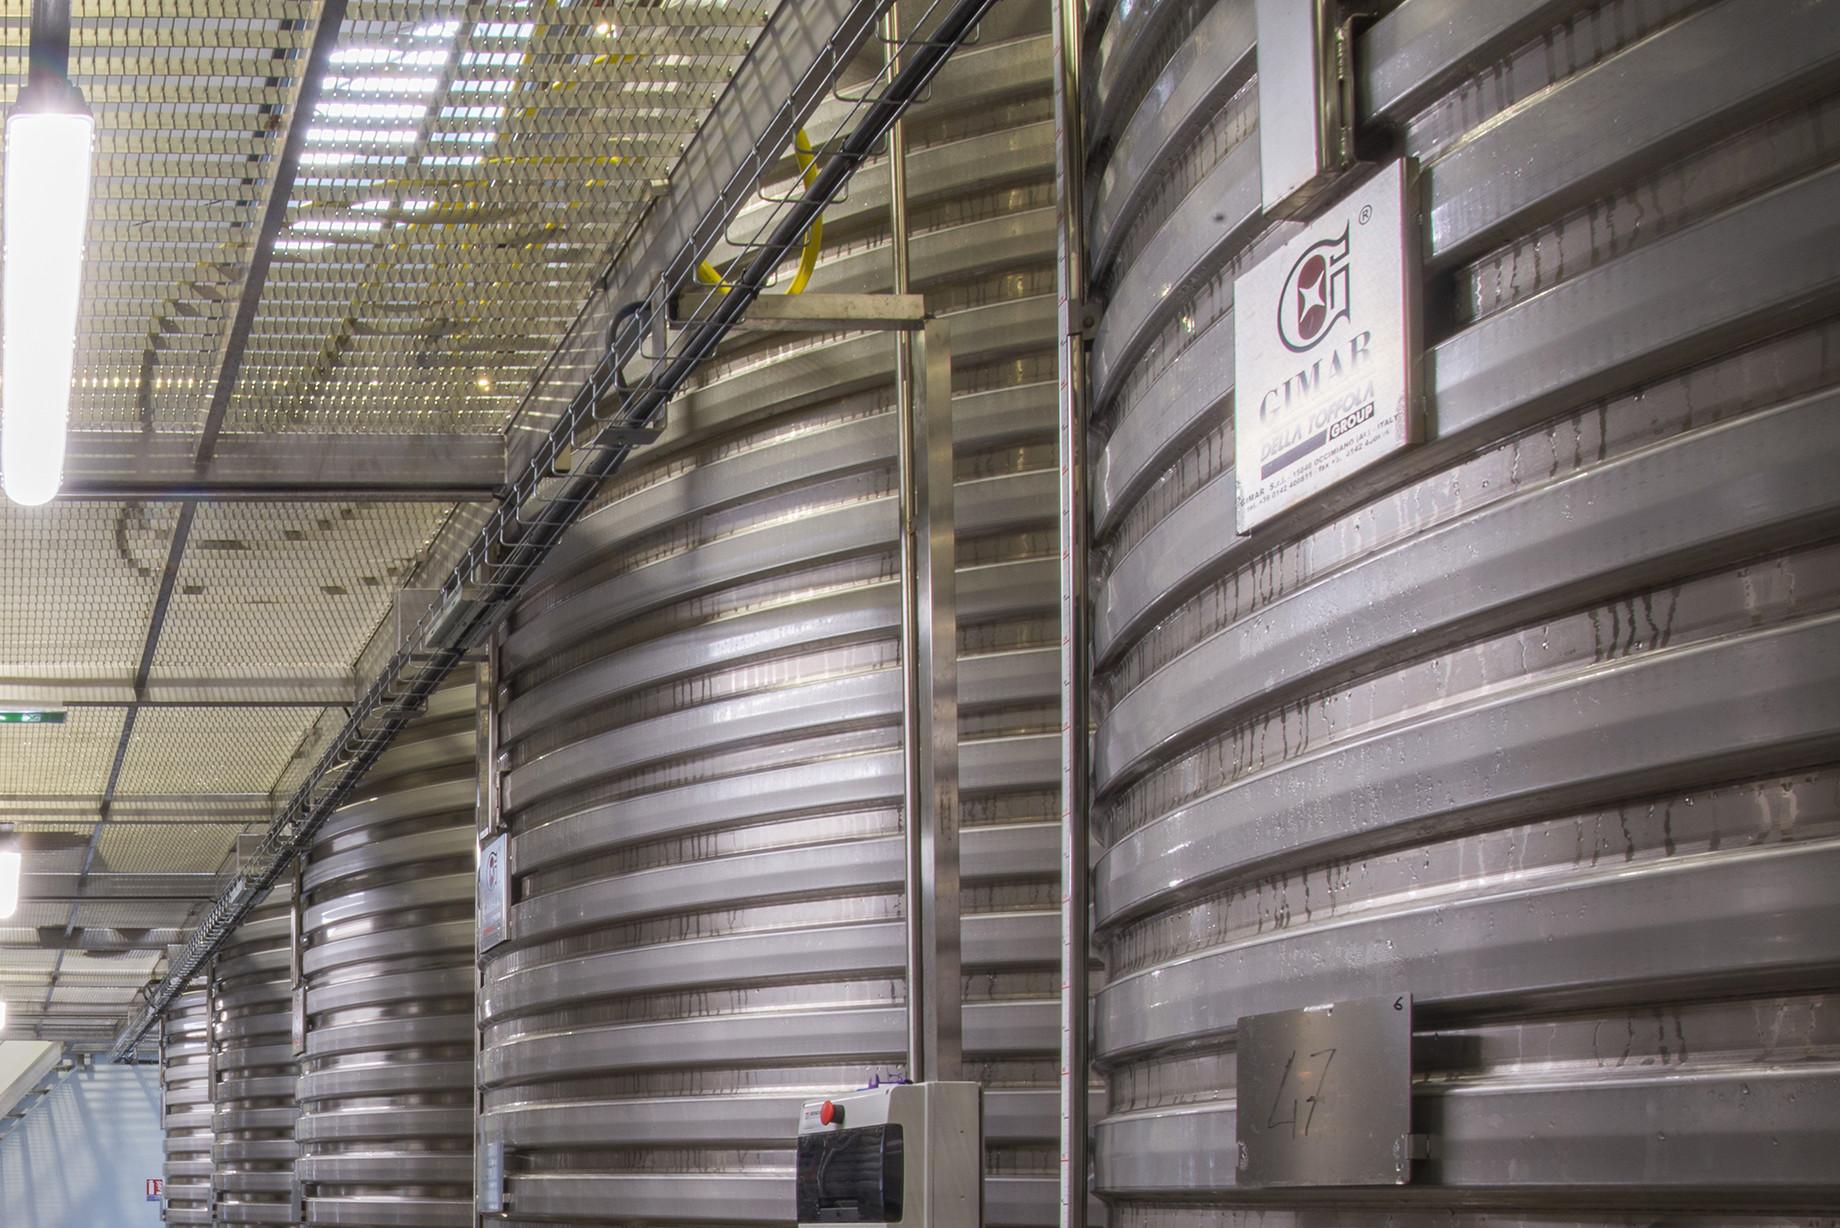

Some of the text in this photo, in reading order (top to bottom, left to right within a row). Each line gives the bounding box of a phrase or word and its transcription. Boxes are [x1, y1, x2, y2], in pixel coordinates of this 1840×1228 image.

[1260, 330, 1372, 425] GIMAR
[1261, 380, 1374, 461] DELLA TOFFOLA
[1330, 404, 1373, 438] GROUP
[1240, 488, 1265, 507] GIMAR
[1314, 438, 1354, 466] OCCIMIANO
[1377, 413, 1399, 429] ITALY
